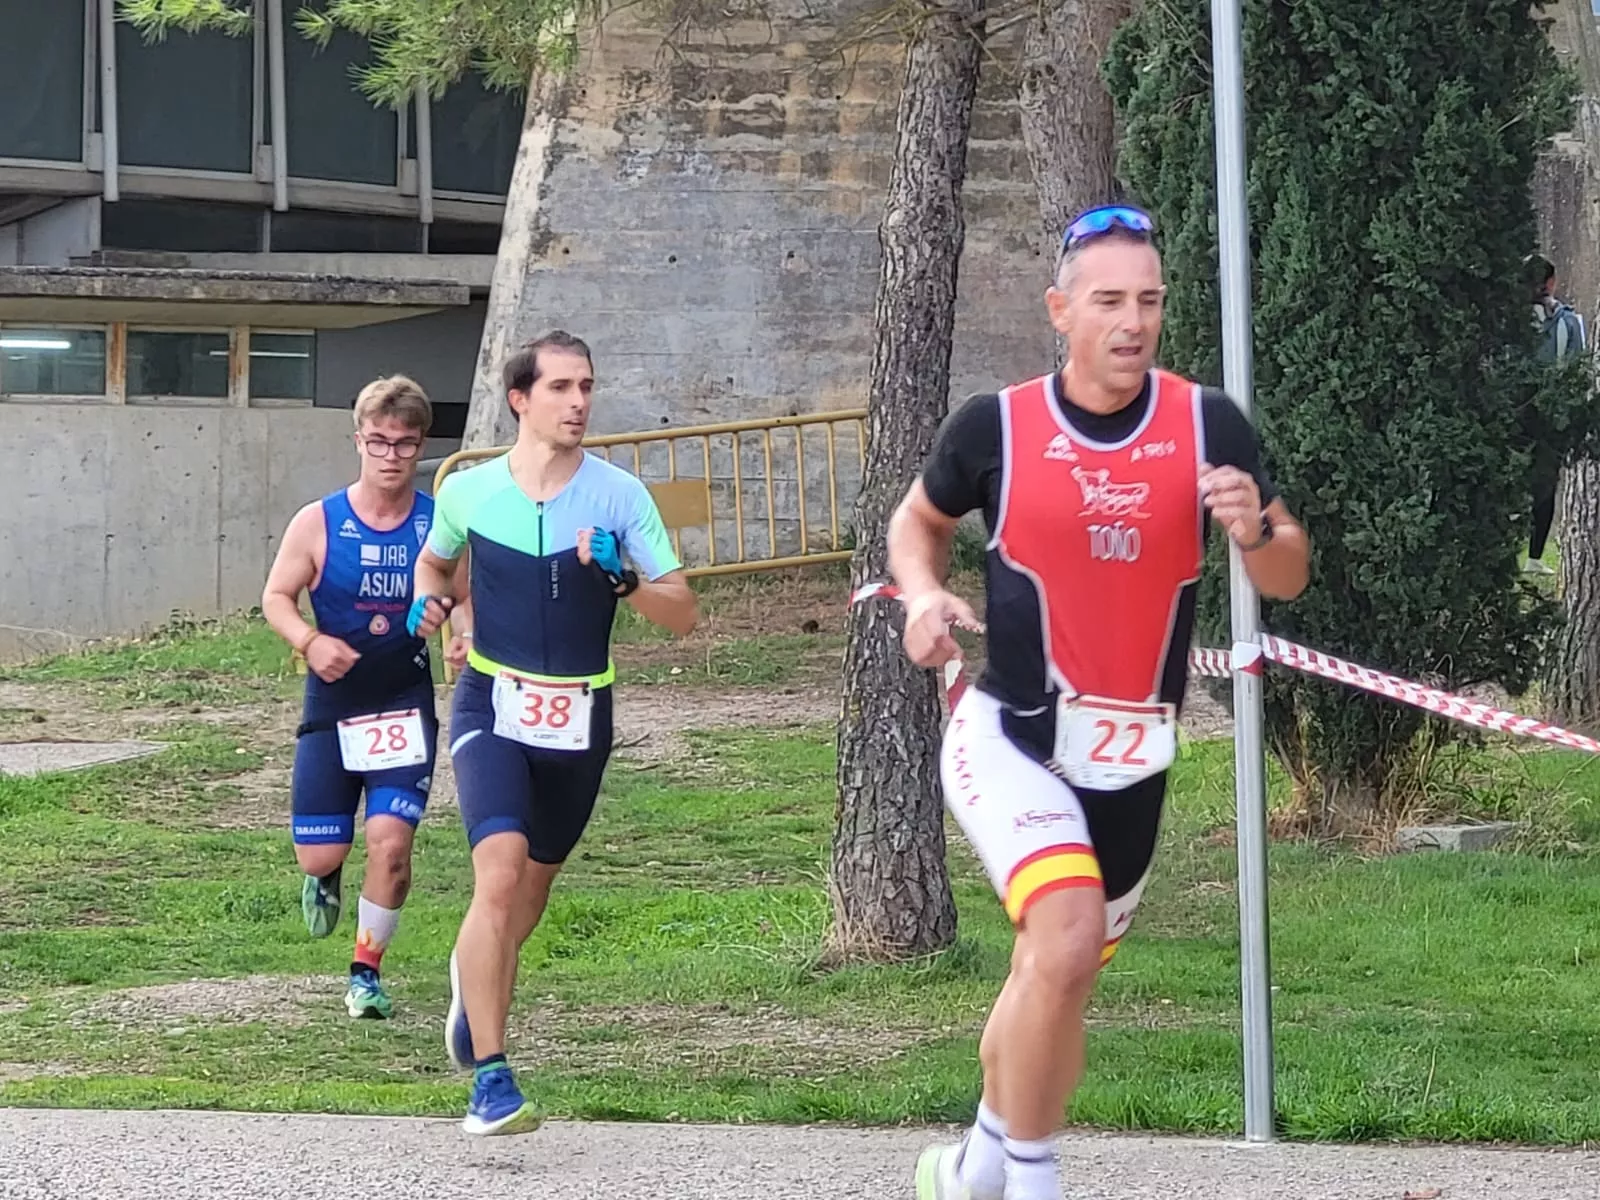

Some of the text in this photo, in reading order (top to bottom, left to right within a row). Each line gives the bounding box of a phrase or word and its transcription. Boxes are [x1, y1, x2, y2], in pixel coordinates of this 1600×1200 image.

[381, 544, 408, 567] JAB
[1087, 520, 1141, 562] TOÑO
[358, 571, 408, 599] ASUN
[519, 692, 572, 729] 38
[364, 723, 409, 756] 28
[1088, 719, 1148, 766] 22
